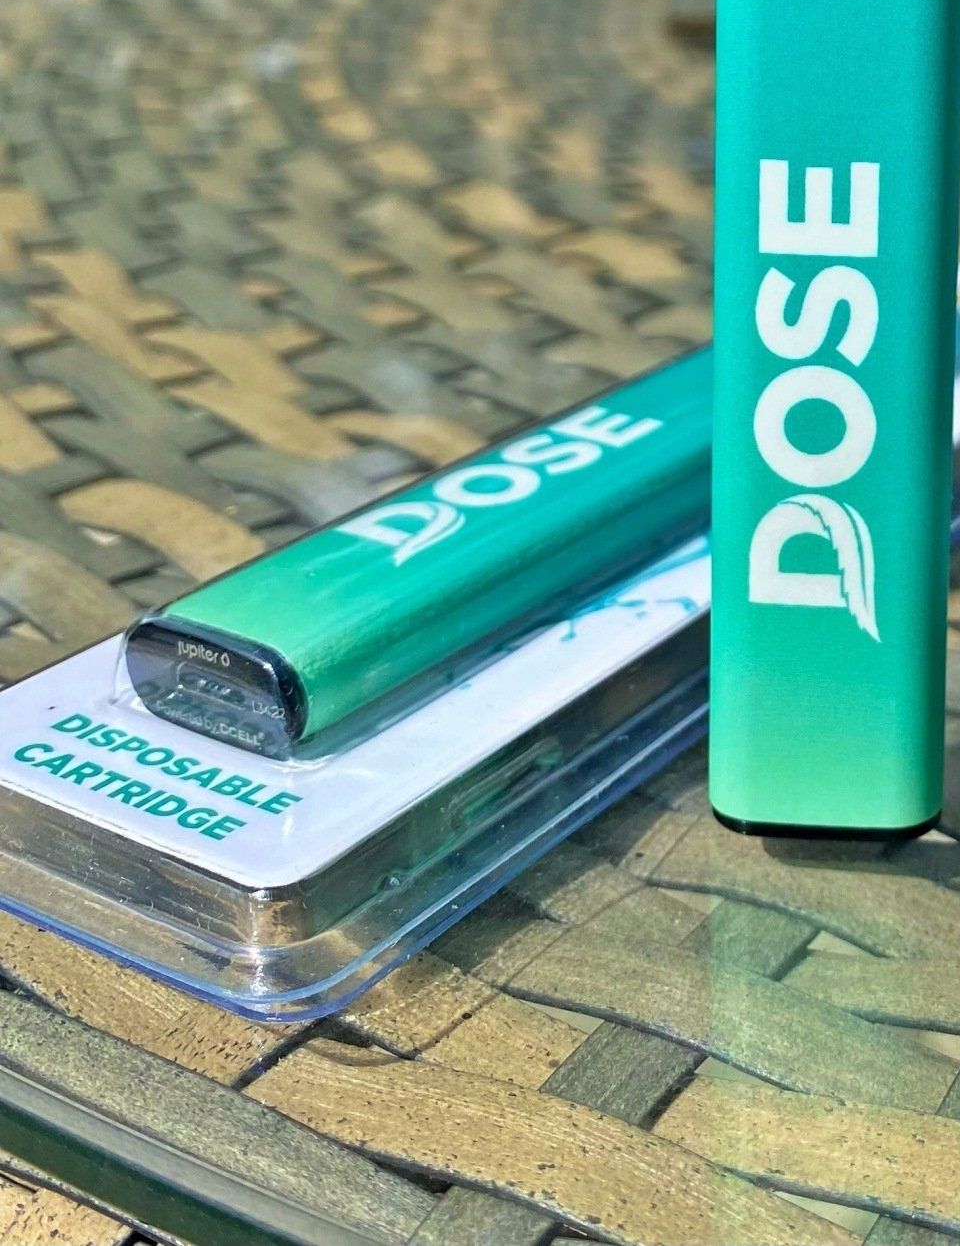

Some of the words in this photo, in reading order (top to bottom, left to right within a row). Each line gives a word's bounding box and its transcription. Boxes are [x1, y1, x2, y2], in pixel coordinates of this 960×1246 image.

[749, 159, 882, 643] DOSE
[336, 406, 662, 566] DOSE
[14, 743, 247, 841] CARTRIDGE
[51, 713, 303, 815] DISPOSABLE
